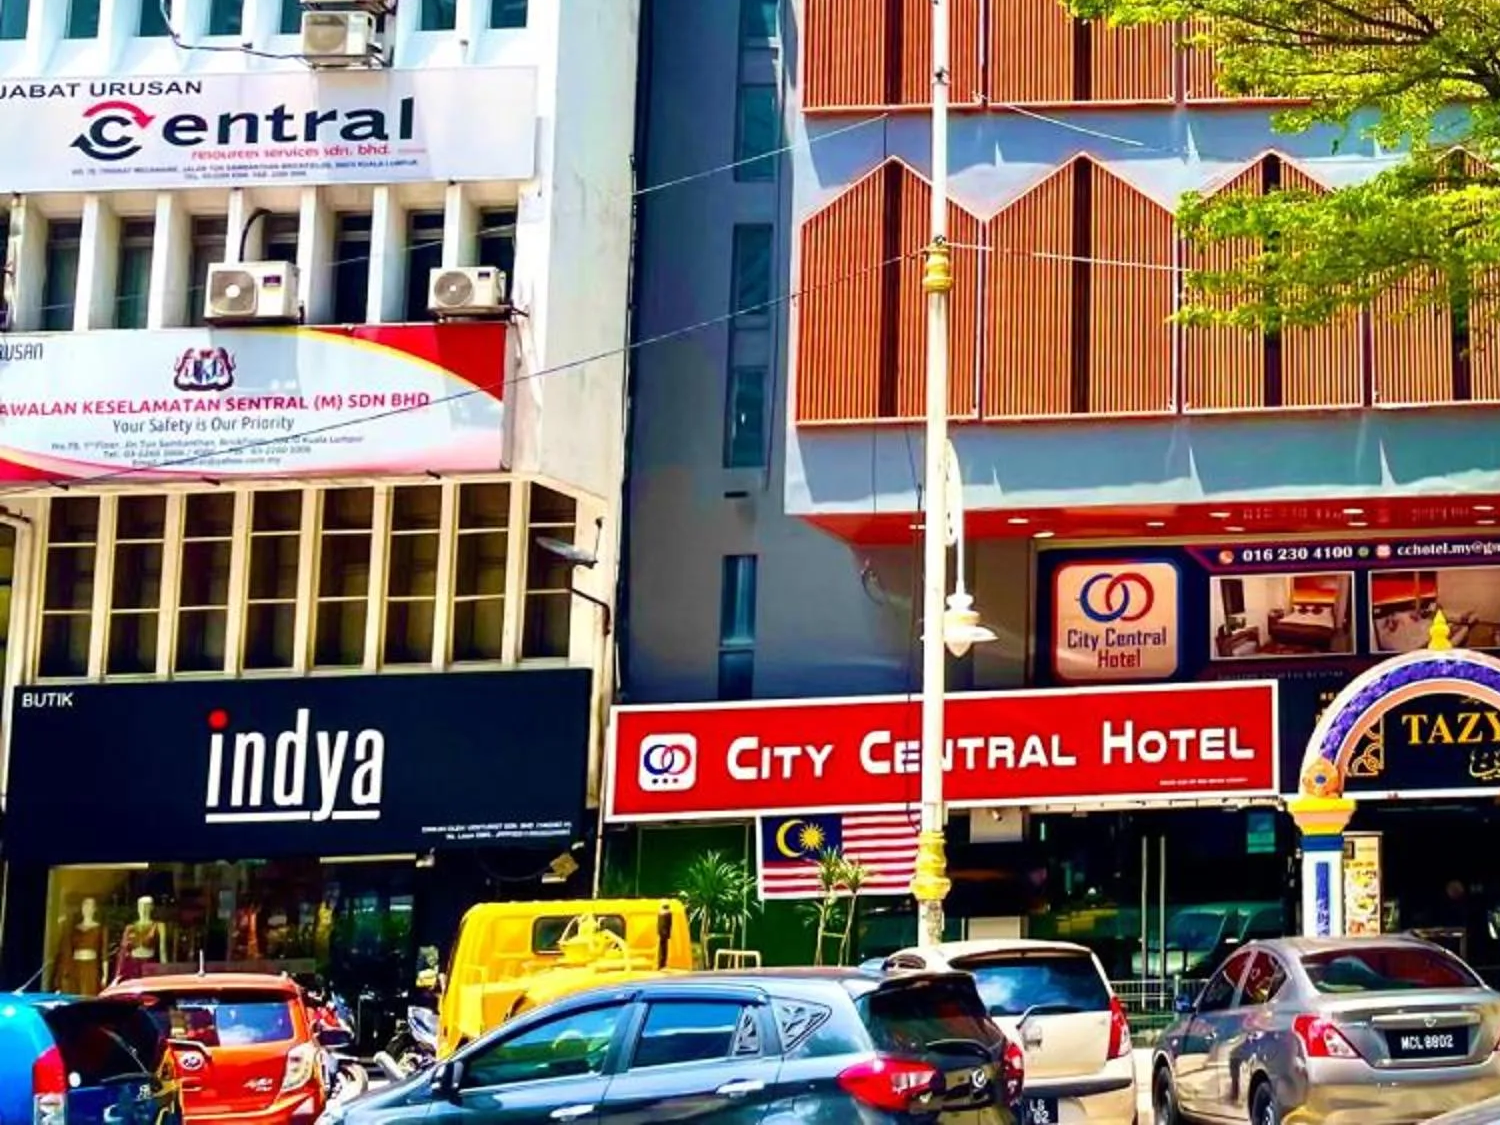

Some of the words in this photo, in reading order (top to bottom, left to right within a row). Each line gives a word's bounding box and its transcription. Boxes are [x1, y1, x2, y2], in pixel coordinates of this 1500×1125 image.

[90, 80, 202, 97] URUSAN
[82, 397, 220, 415] KESELAMATAN
[225, 395, 308, 412] SENTRAL
[313, 394, 343, 411] (M)
[347, 394, 387, 408] SDN
[391, 392, 430, 408] BHD
[113, 419, 145, 433] Your
[149, 417, 193, 434] Safety
[196, 416, 207, 431] is
[211, 416, 237, 431] Our
[241, 415, 295, 432] Priority
[1243, 549, 1273, 561] 016
[1278, 548, 1308, 560] 230
[1313, 547, 1353, 559] 4100
[1068, 629, 1099, 650] City
[1106, 627, 1166, 646] Central
[1098, 649, 1141, 668] Hotel
[23, 693, 73, 707] BUTIK
[727, 737, 833, 779] CITY
[1103, 721, 1255, 764] HOTEL
[205, 709, 385, 820] indya
